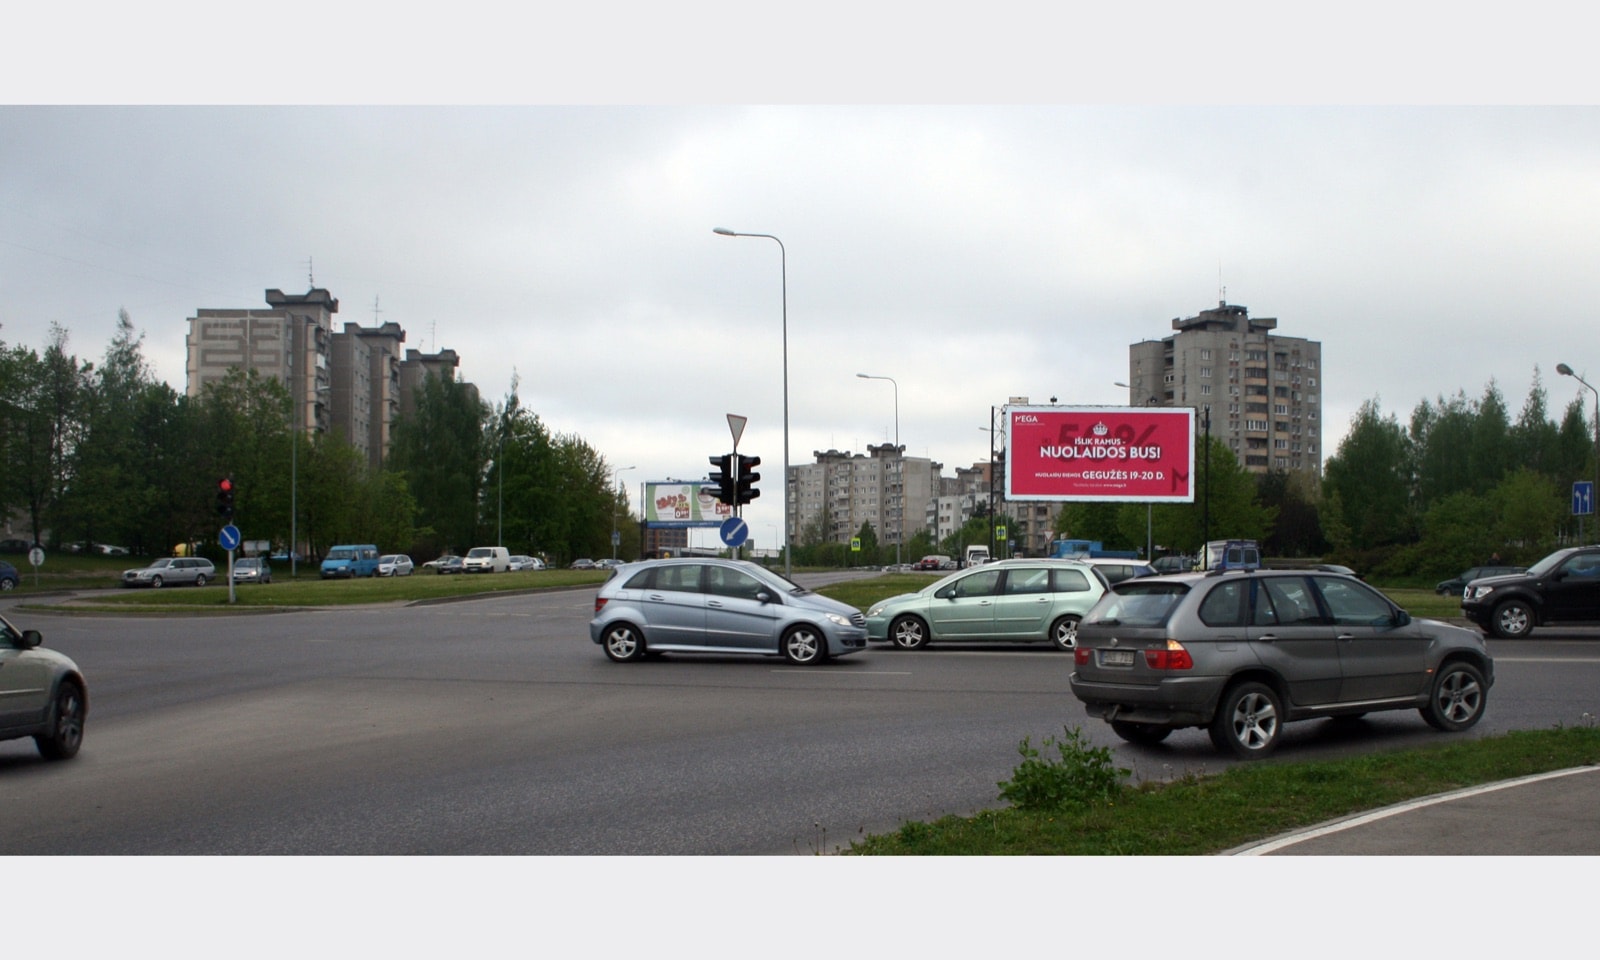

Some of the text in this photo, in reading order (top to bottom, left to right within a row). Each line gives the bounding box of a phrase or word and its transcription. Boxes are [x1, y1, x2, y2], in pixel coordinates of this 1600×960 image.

[1015, 415, 1038, 423] MEGA
[1074, 436, 1093, 445] IŠLIK
[1040, 446, 1161, 458] NUOLAIDOS BUS!
[1130, 471, 1154, 480] 19-20
[1156, 471, 1165, 480] D.
